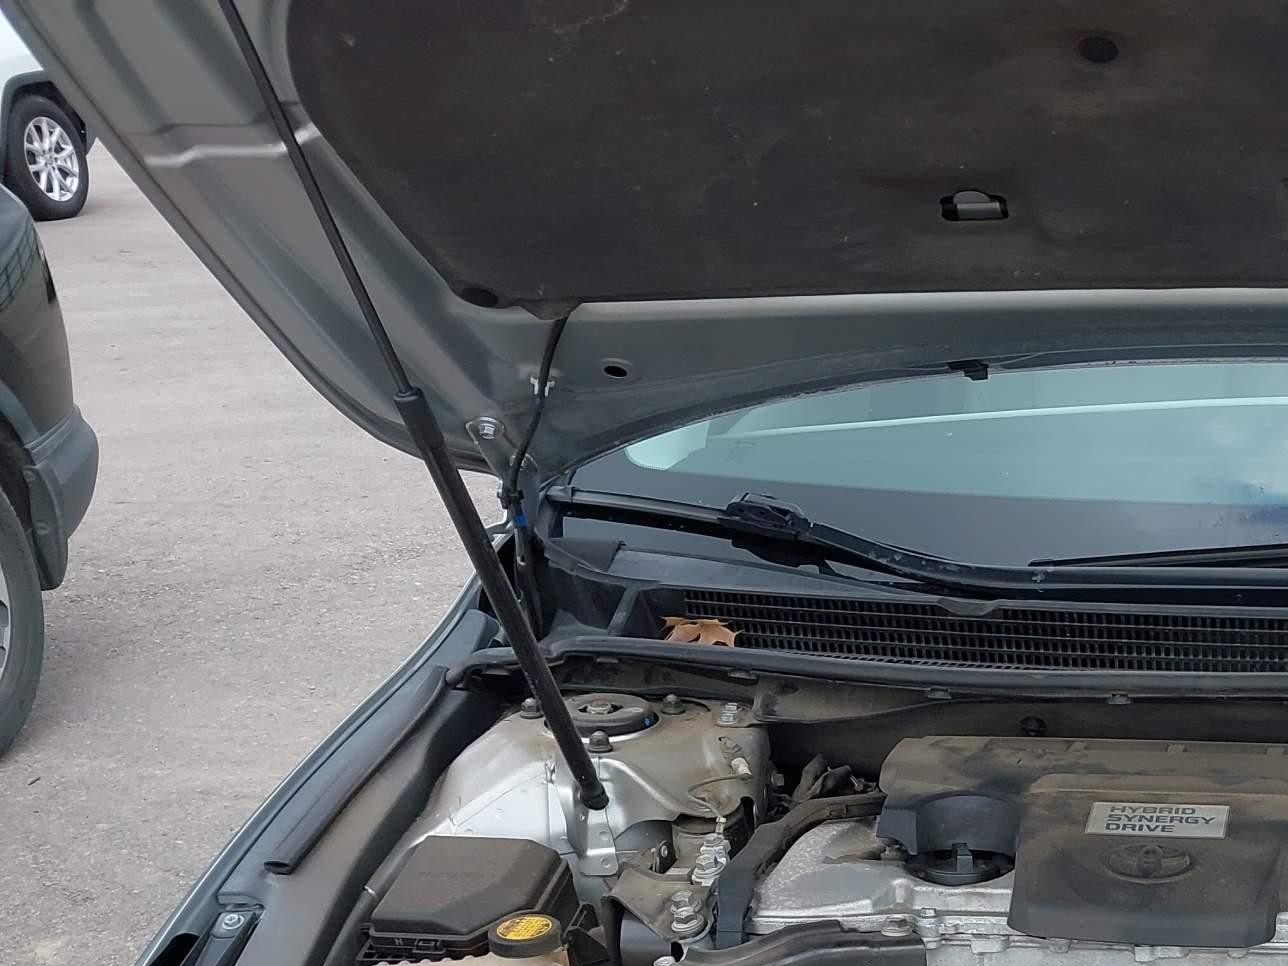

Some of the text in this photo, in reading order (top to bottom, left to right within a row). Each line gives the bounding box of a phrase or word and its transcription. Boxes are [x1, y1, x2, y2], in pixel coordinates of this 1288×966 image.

[1110, 806, 1195, 815] HYBRID
[1108, 814, 1215, 824] SYNERGY
[1105, 823, 1175, 832] DRIVE
